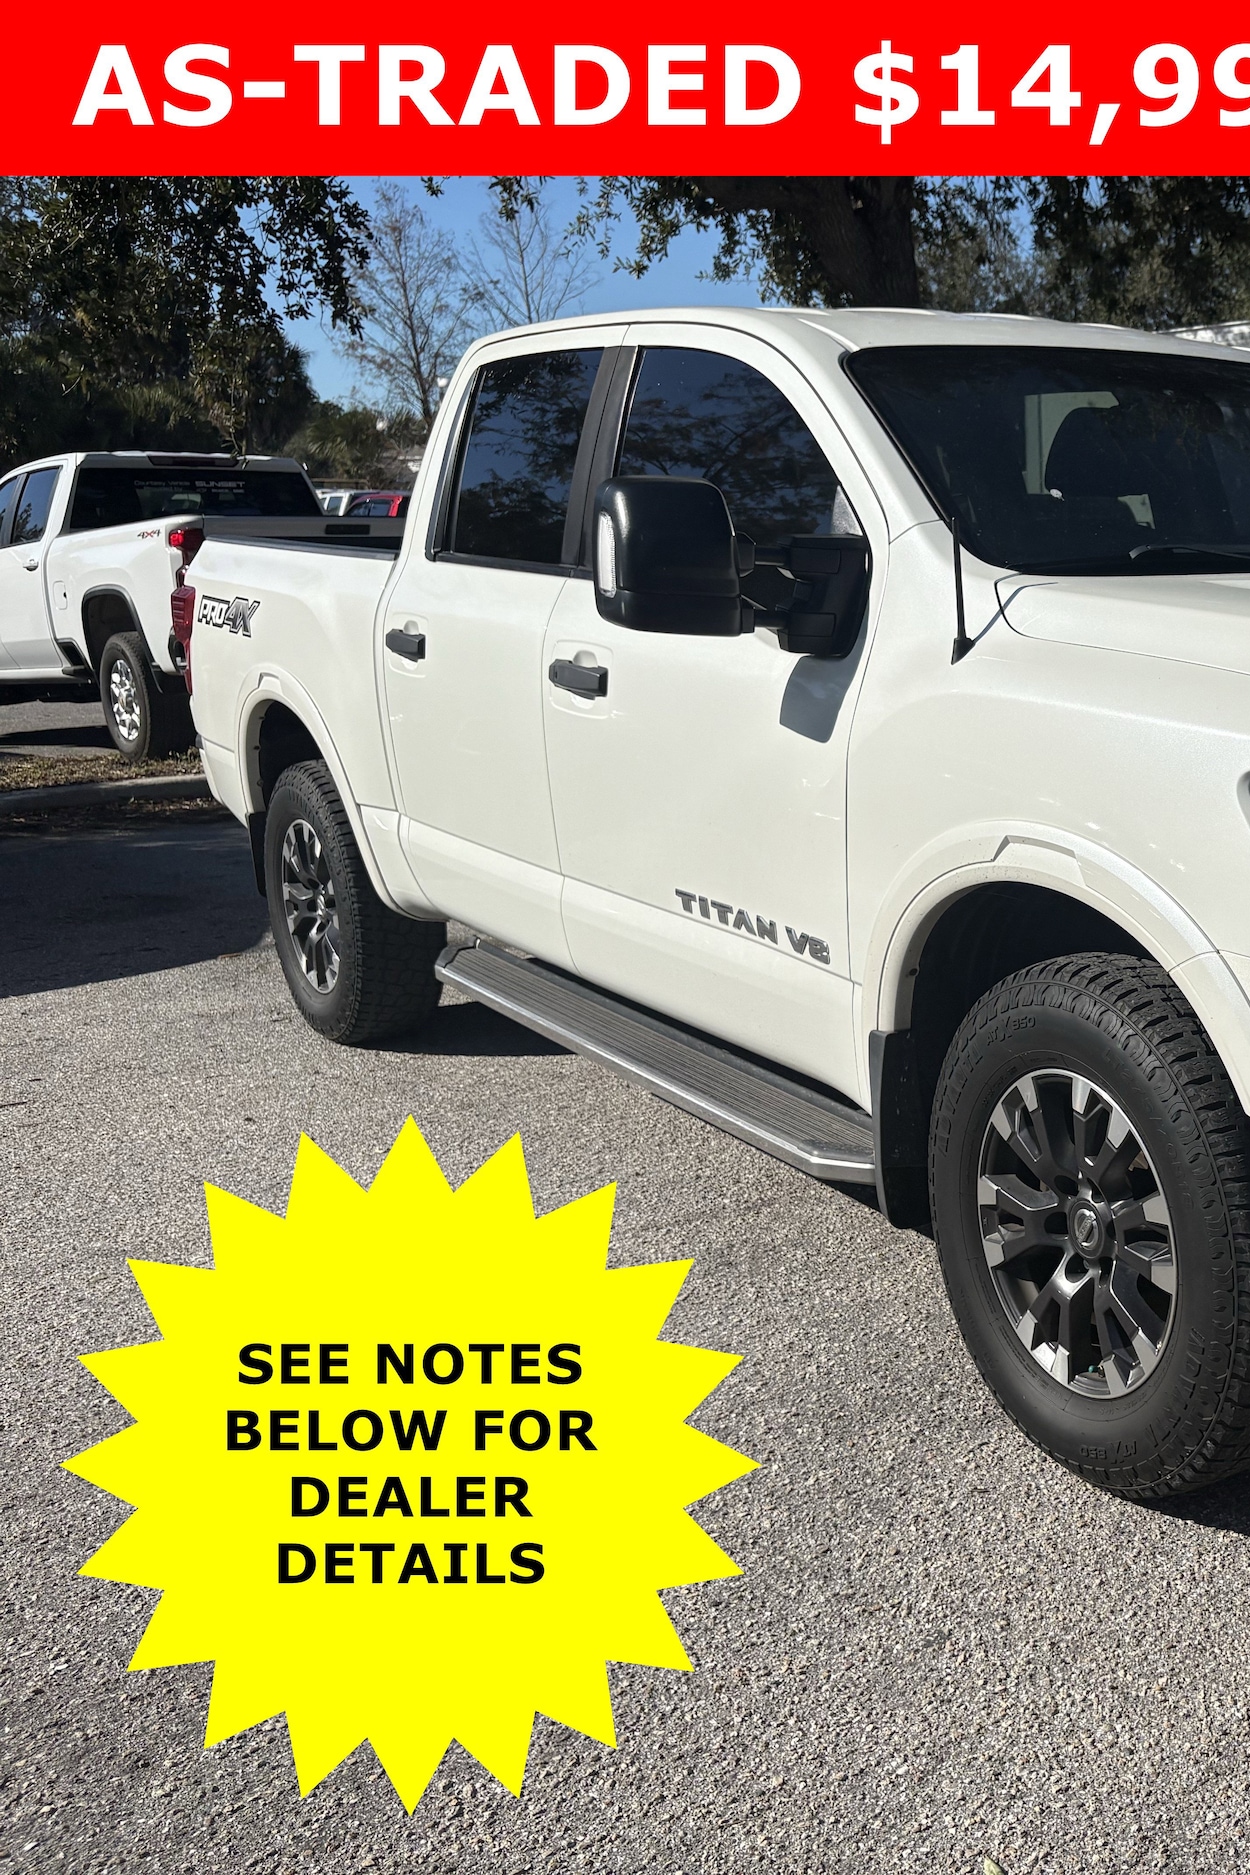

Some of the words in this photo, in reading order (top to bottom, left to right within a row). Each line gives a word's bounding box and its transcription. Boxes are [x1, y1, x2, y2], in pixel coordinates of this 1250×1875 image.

[195, 480, 245, 489] SUNSET
[675, 888, 778, 946] TITAN
[784, 925, 832, 965] V8
